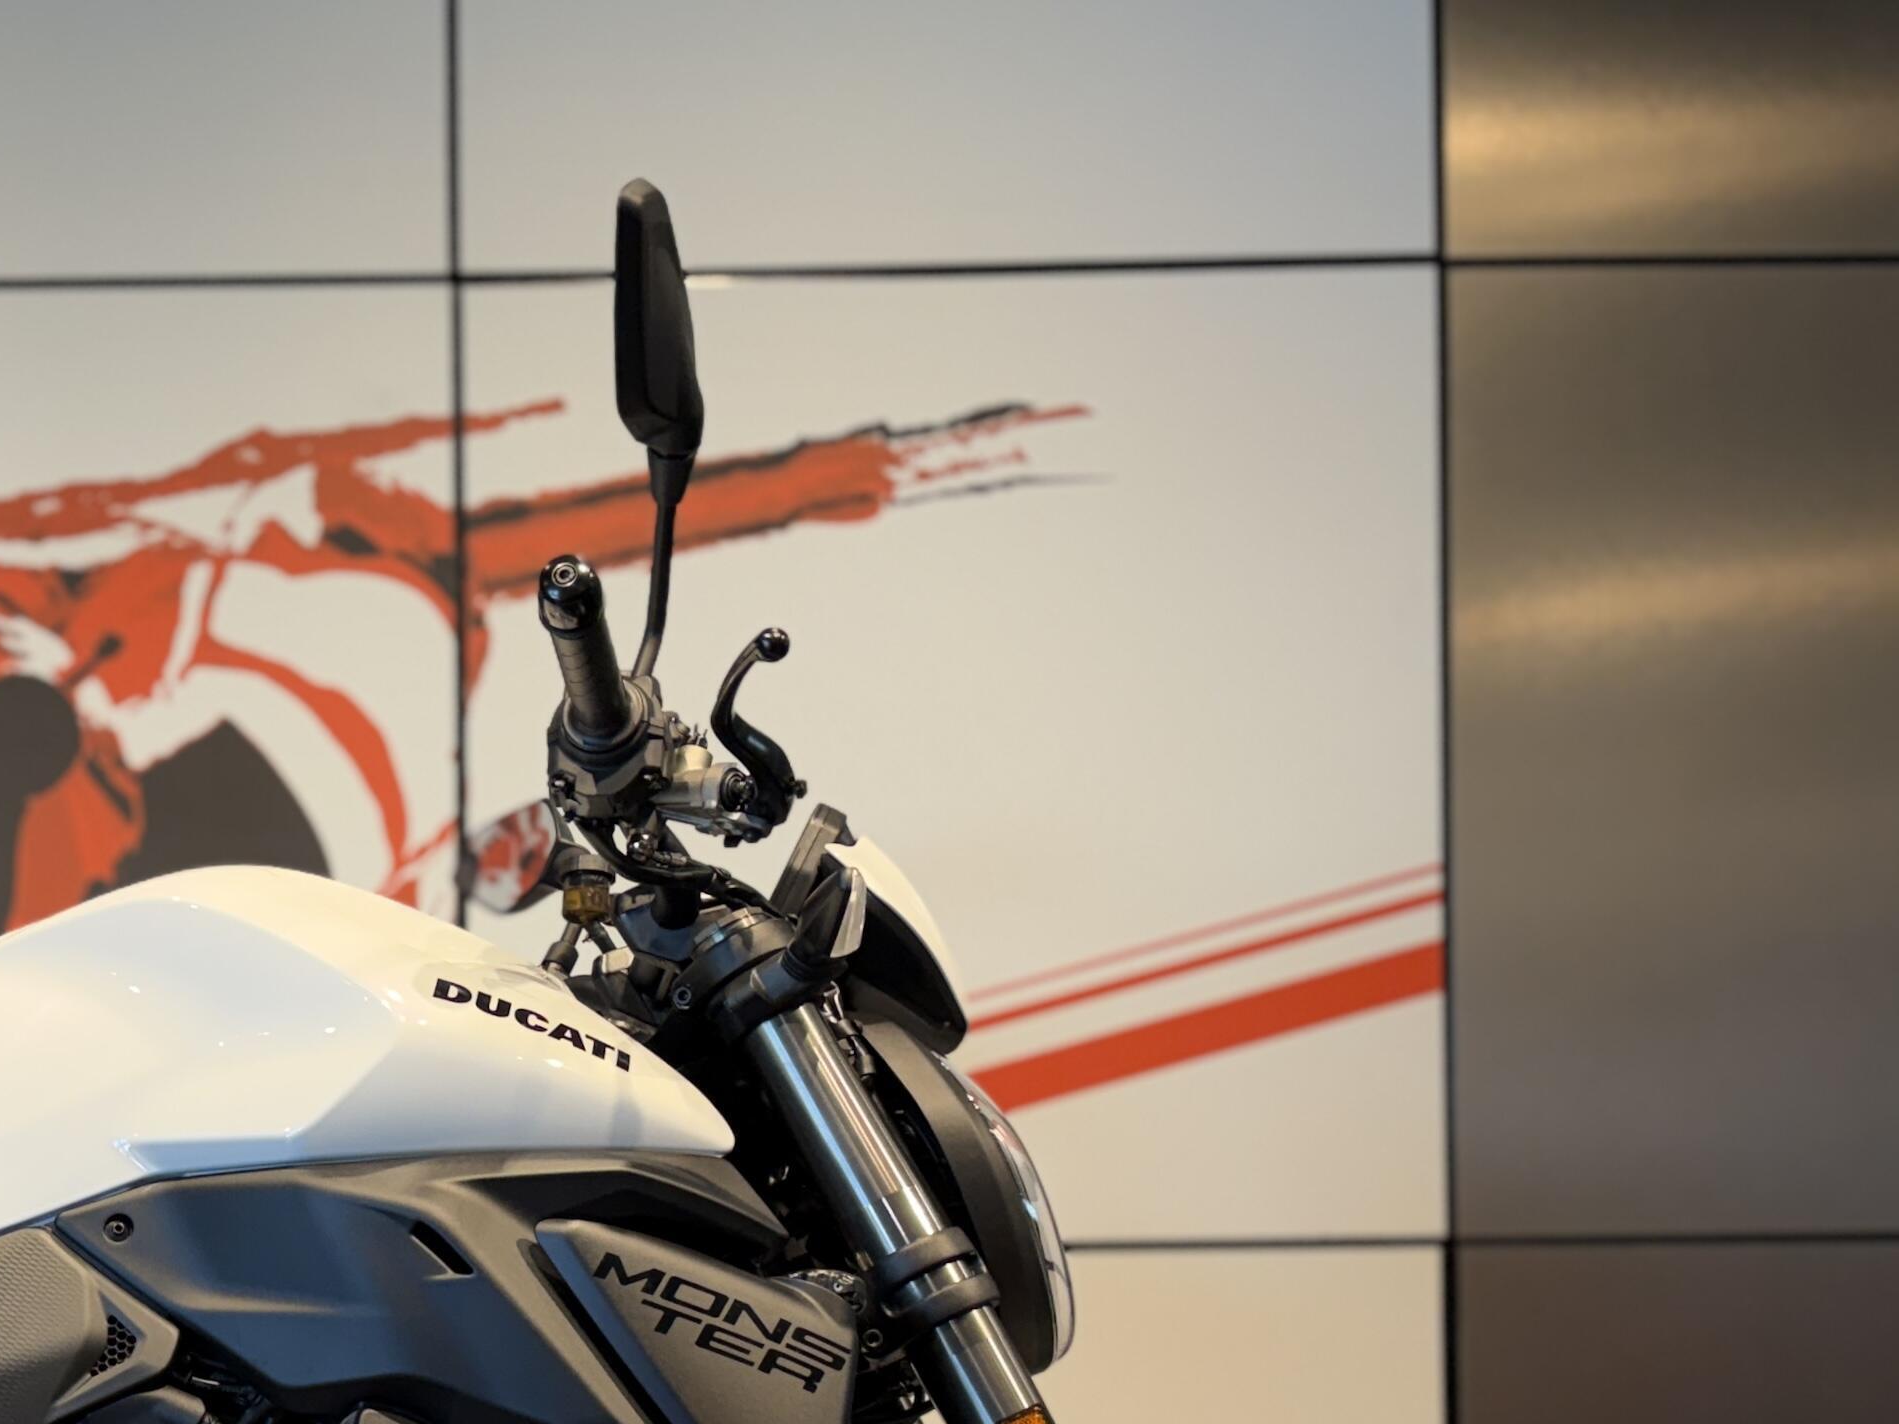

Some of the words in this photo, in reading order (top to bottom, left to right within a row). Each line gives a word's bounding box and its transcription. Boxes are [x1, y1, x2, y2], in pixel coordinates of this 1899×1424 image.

[433, 978, 632, 1072] DUCATI
[593, 1252, 851, 1371] MONS
[641, 1299, 825, 1393] TER
